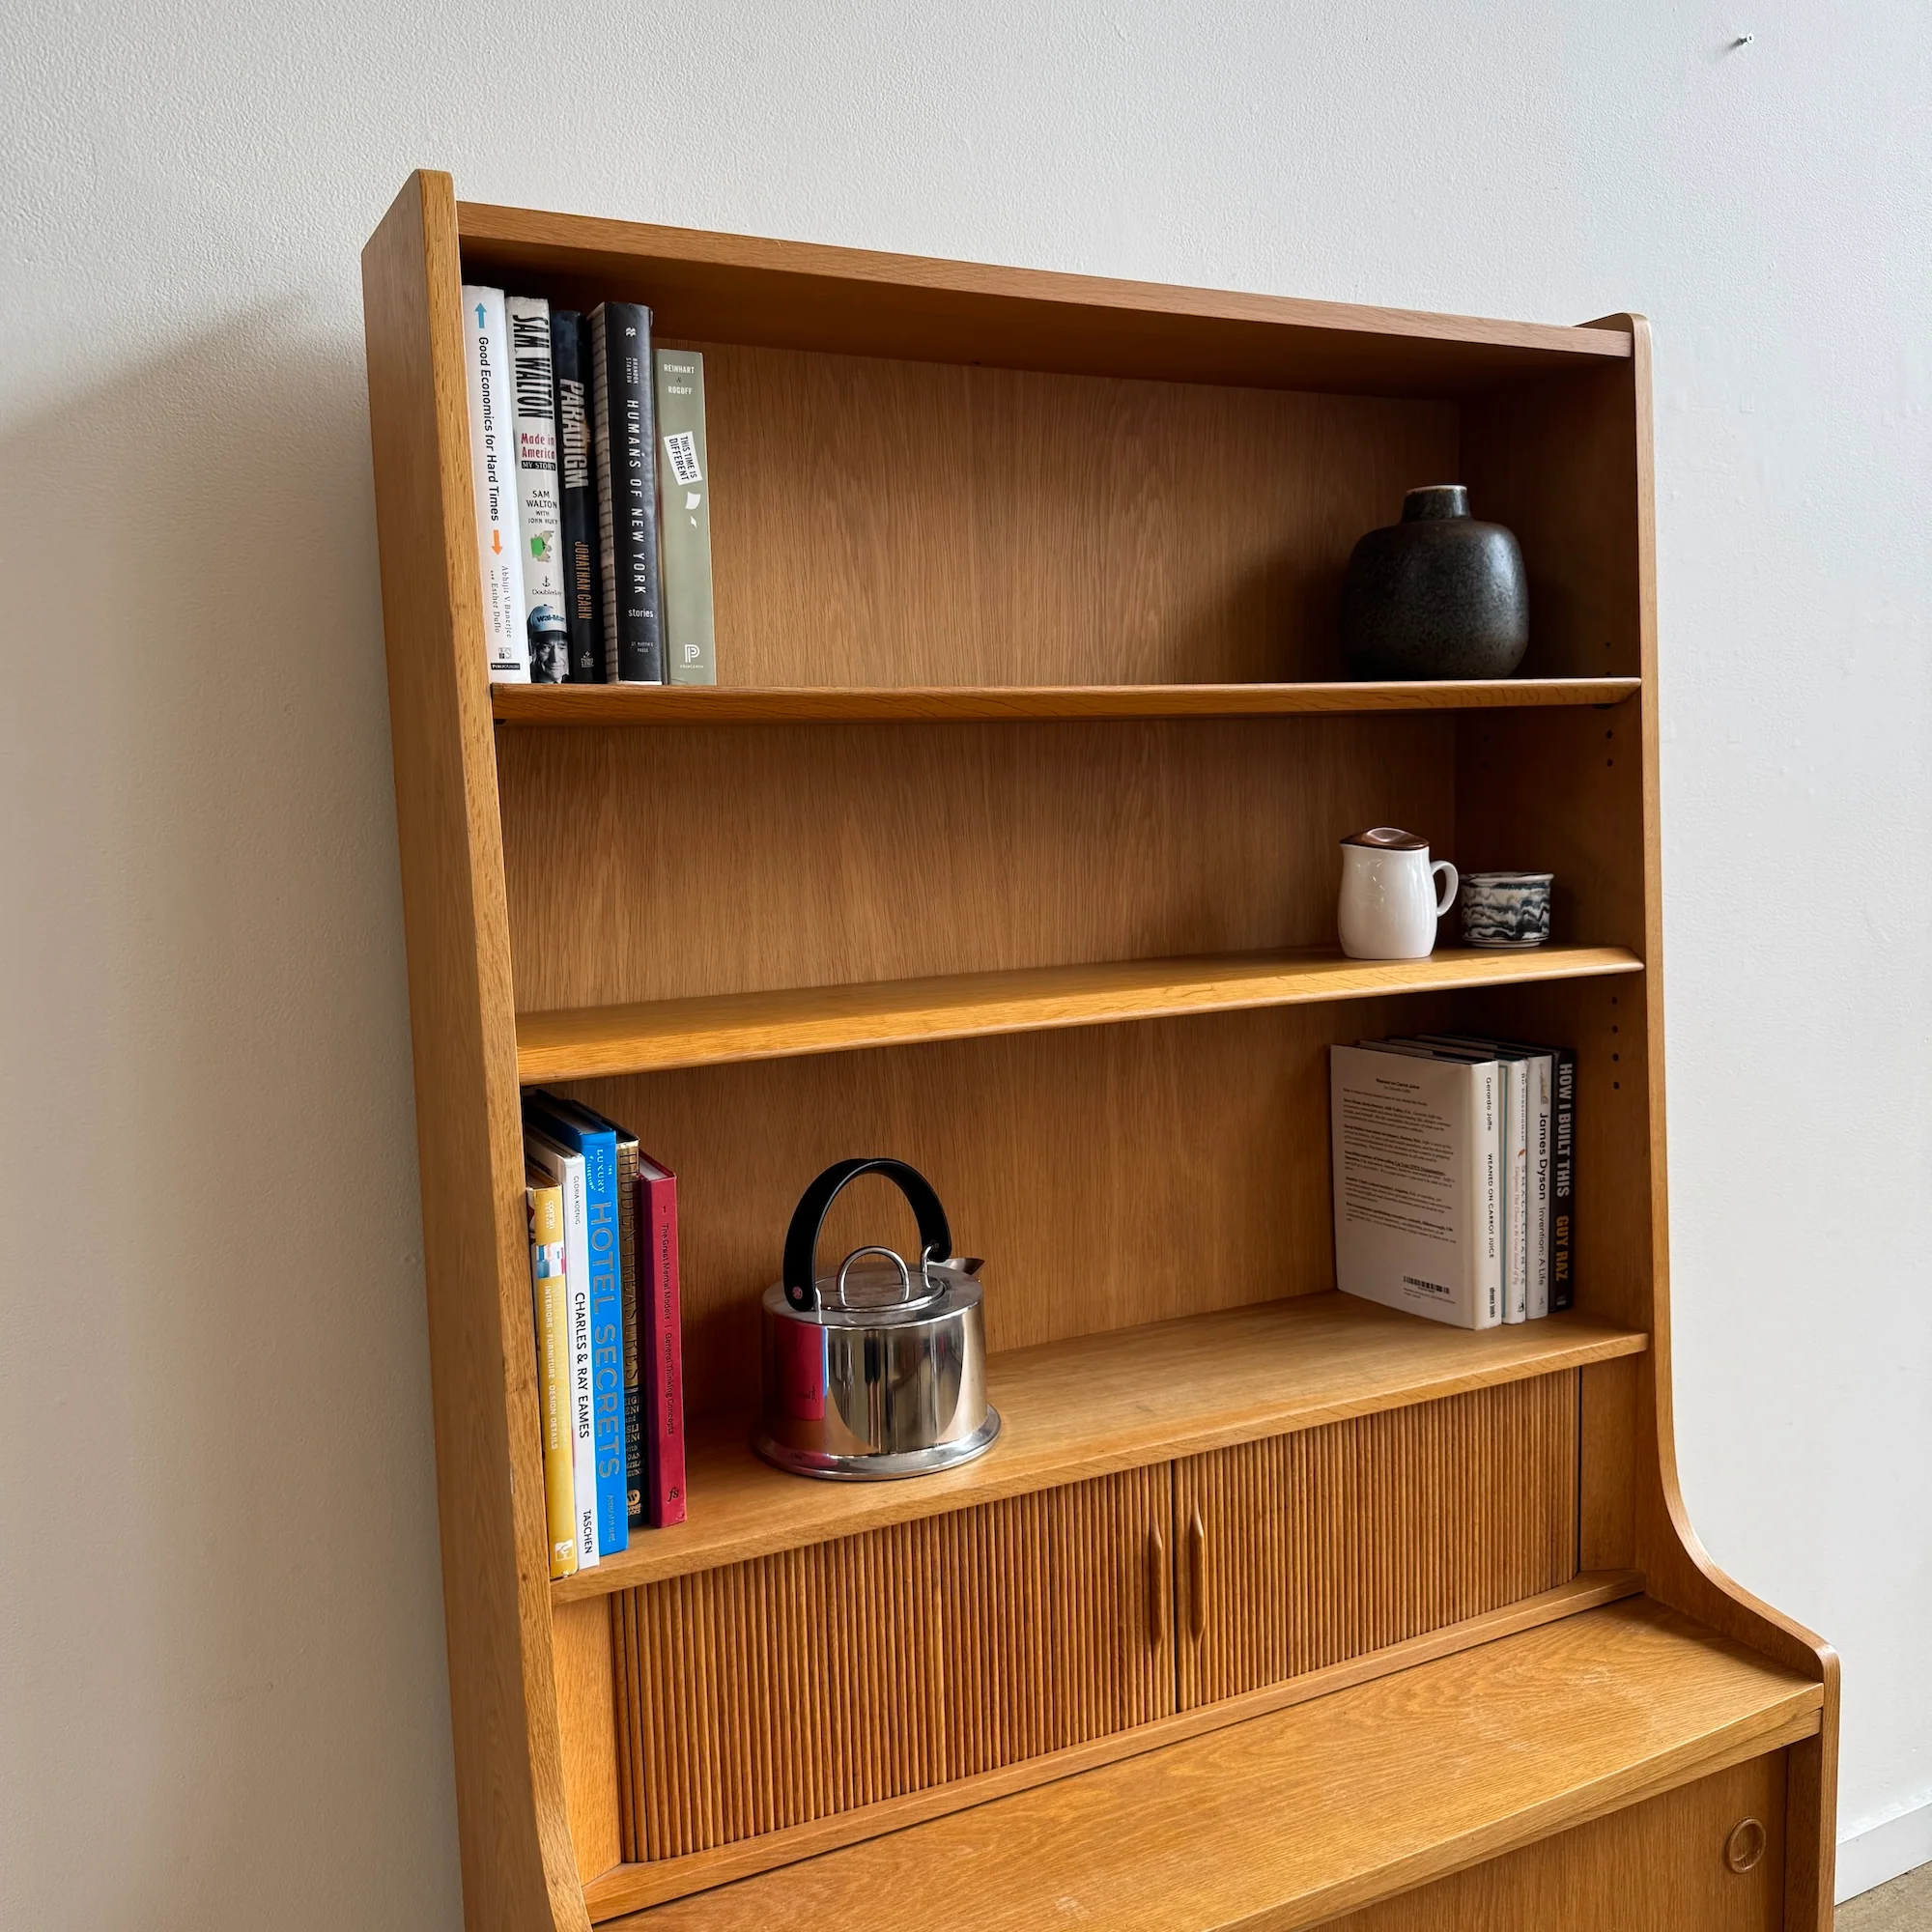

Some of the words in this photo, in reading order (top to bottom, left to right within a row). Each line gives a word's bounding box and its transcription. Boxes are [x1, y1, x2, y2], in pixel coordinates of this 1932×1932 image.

[512, 315, 549, 348] SAM
[479, 337, 491, 366] Good
[664, 364, 695, 374] REINHART
[481, 370, 494, 431] Economics
[515, 357, 554, 419] WALTON
[485, 435, 496, 451] for
[522, 433, 545, 444] Made
[548, 435, 554, 444] in
[560, 378, 588, 489] PARADIGM
[626, 400, 641, 468] HUMANS
[680, 436, 691, 451] THIS
[522, 446, 555, 459] America
[535, 462, 555, 470] STORY
[668, 438, 690, 480] DIFFERENT
[684, 452, 696, 469] TIME
[487, 455, 498, 483] Hard
[532, 490, 550, 498] SAM
[630, 478, 642, 497] OF
[489, 487, 499, 521] Times
[526, 499, 557, 509] WALTON
[631, 508, 644, 542] NEW
[501, 565, 510, 594] Abhijit
[575, 541, 590, 590] JONATHAN
[633, 553, 646, 594] YORK
[491, 582, 499, 609] Esther
[577, 594, 592, 619] CAHN
[628, 609, 654, 617] stories
[1559, 1064, 1573, 1099] HOW
[1539, 1113, 1548, 1155] James
[1557, 1113, 1571, 1156] BUILT
[596, 1150, 605, 1193] LUXURY
[1537, 1159, 1548, 1200] Dyson
[1556, 1159, 1570, 1197] THIS
[1488, 1189, 1493, 1201] ON
[1556, 1215, 1569, 1246] GUY
[590, 1202, 614, 1314] HOTEL
[1539, 1258, 1546, 1266] A
[1555, 1251, 1568, 1282] RAZ
[545, 1286, 554, 1328] INTERIORS
[575, 1292, 586, 1350] CHARLES
[547, 1334, 555, 1378] FURNITURE
[577, 1353, 587, 1364] &
[578, 1367, 588, 1390] RAY
[579, 1395, 589, 1438] EAMES
[595, 1323, 619, 1479] SECRETS
[550, 1417, 558, 1449] DETAILS
[668, 1487, 679, 1502] fs
[583, 1509, 593, 1554] TASCHEN
